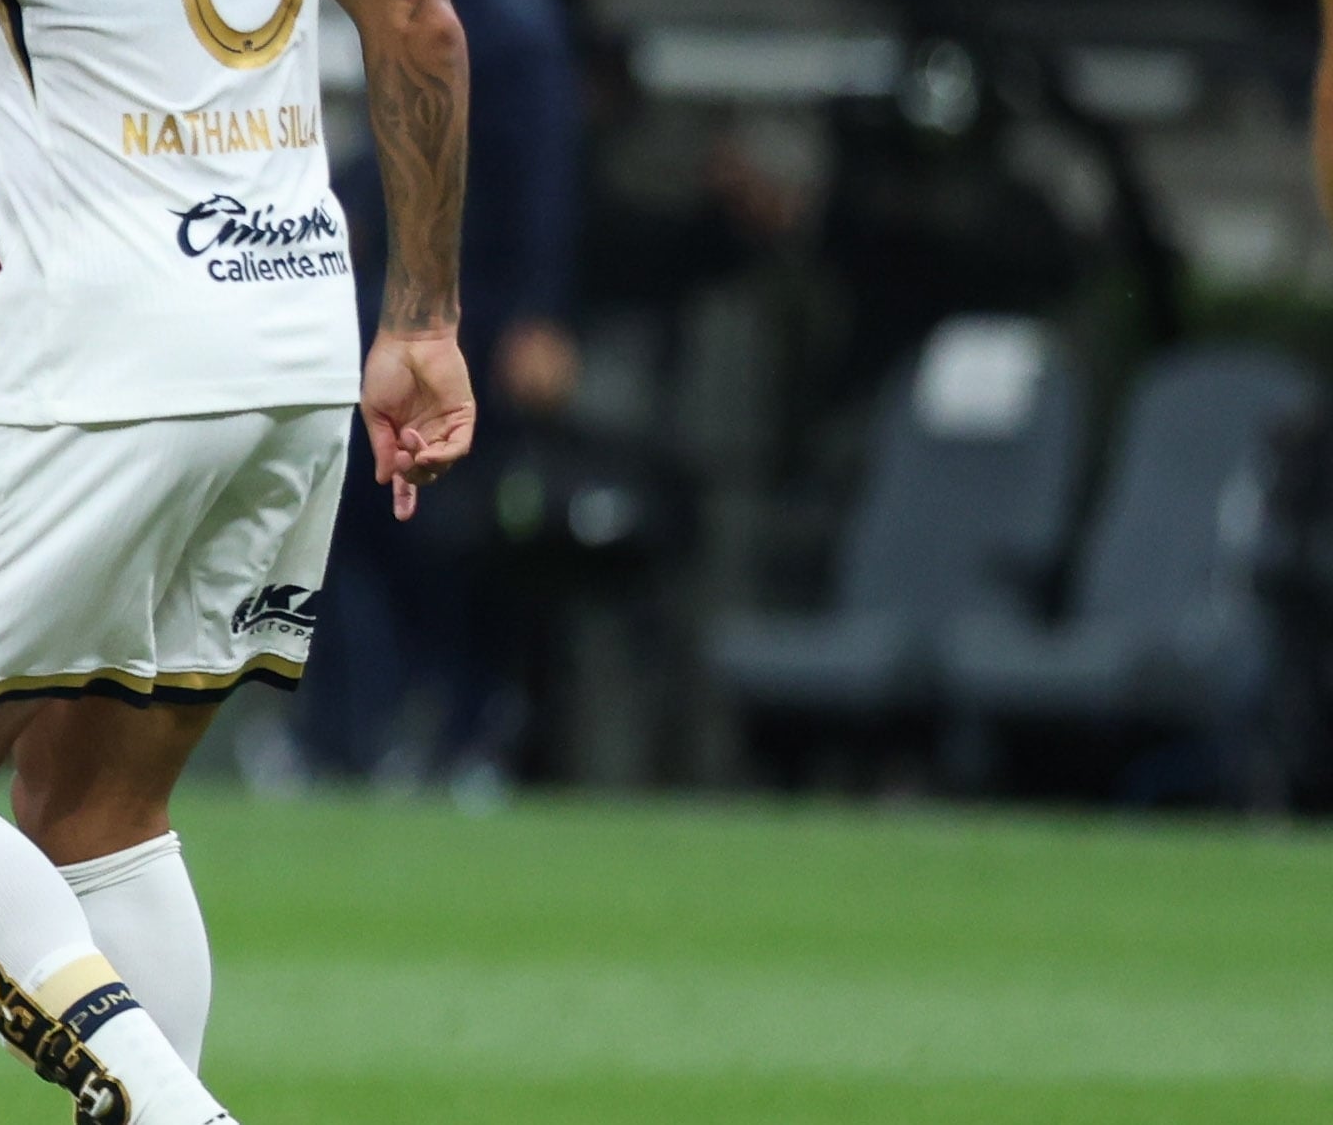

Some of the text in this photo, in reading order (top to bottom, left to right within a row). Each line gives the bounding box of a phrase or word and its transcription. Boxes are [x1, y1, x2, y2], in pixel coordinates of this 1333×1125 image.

[122, 109, 273, 156] NATHAN
[208, 250, 349, 282] caliente.mx
[68, 990, 132, 1034] PUM
